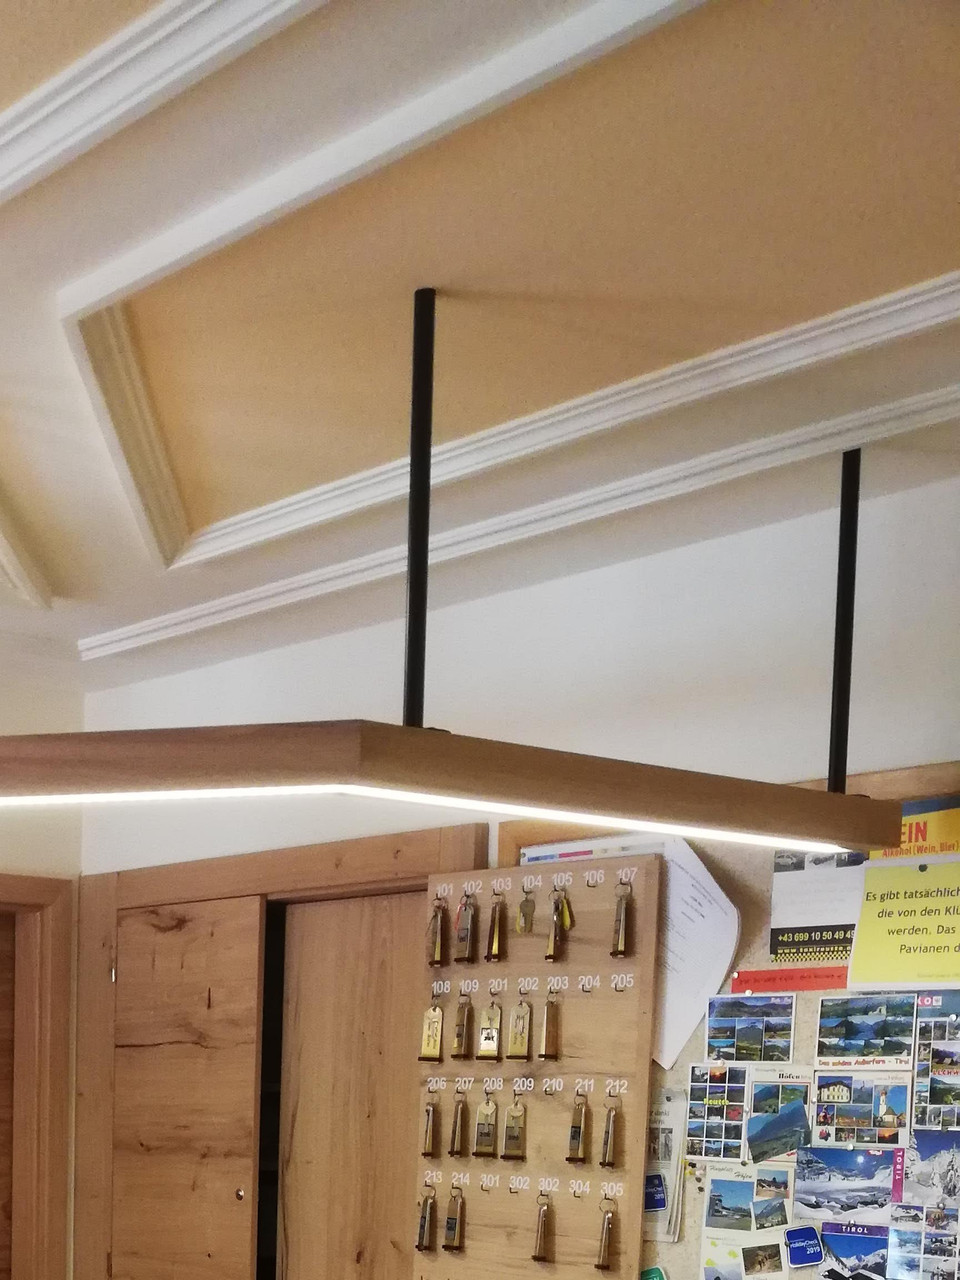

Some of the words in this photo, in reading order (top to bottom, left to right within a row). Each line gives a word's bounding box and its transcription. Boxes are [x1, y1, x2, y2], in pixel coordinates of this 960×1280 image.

[882, 846, 912, 858] Alkohol
[436, 883, 453, 895] 101
[462, 880, 482, 893] 102
[491, 878, 512, 891] 103
[522, 875, 543, 889] 104
[552, 872, 573, 886] 105
[583, 869, 604, 884] 106
[617, 867, 637, 881] 107
[865, 891, 877, 901] Es
[880, 890, 900, 902] gibt
[878, 908, 894, 918] die
[897, 909, 916, 917] von
[920, 907, 940, 916] den
[778, 932, 793, 942] +43
[794, 931, 809, 942] 699
[811, 931, 821, 940] 10
[822, 931, 833, 940] 50
[834, 930, 845, 940] 49
[887, 926, 932, 936] werden.
[937, 925, 956, 934] Das
[900, 944, 950, 954] Pavianen
[432, 981, 451, 994] 108
[459, 979, 479, 992] 109
[489, 978, 508, 991] 201
[518, 977, 538, 991] 202
[548, 976, 569, 990] 203
[578, 976, 600, 989] 204
[611, 974, 634, 988] 205
[427, 1077, 447, 1090] 206
[455, 1077, 475, 1090] 207
[483, 1077, 503, 1090] 208
[513, 1077, 534, 1091] 209
[542, 1078, 563, 1092] 210
[575, 1078, 594, 1092] 211
[605, 1079, 628, 1093] 212
[424, 1171, 443, 1183] 213
[451, 1172, 470, 1185] 214
[480, 1174, 500, 1187] 301
[509, 1176, 530, 1190] 302
[538, 1177, 560, 1192] 302
[569, 1180, 590, 1194] 304
[600, 1182, 624, 1196] 305
[842, 1225, 868, 1234] TIROL
